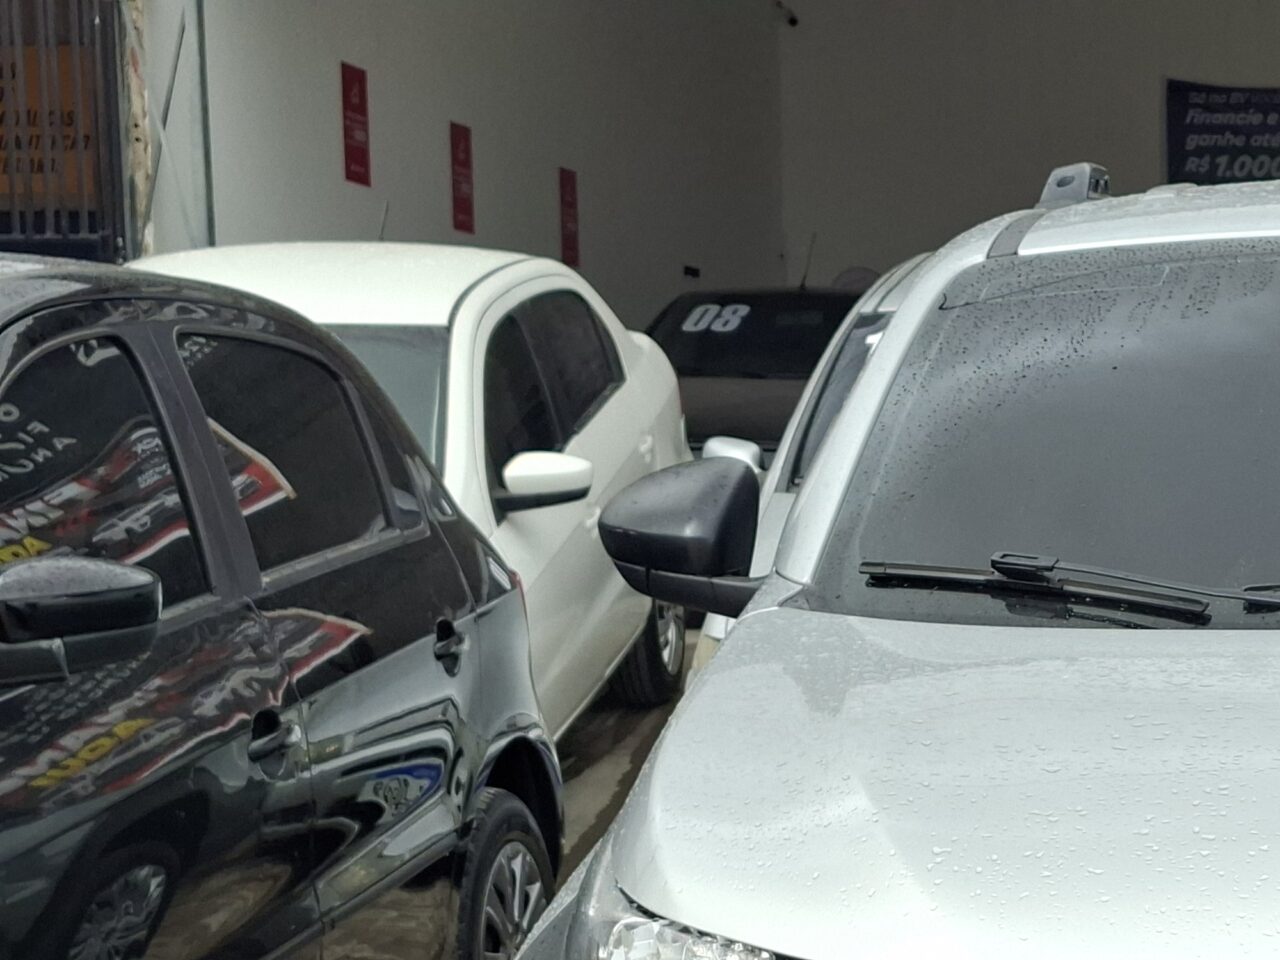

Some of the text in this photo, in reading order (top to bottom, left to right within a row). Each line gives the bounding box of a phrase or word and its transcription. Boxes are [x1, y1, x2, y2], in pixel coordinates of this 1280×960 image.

[1267, 112, 1280, 125] e
[1185, 131, 1246, 150] ganhe
[1185, 154, 1210, 174] R$
[682, 303, 752, 332] 08
